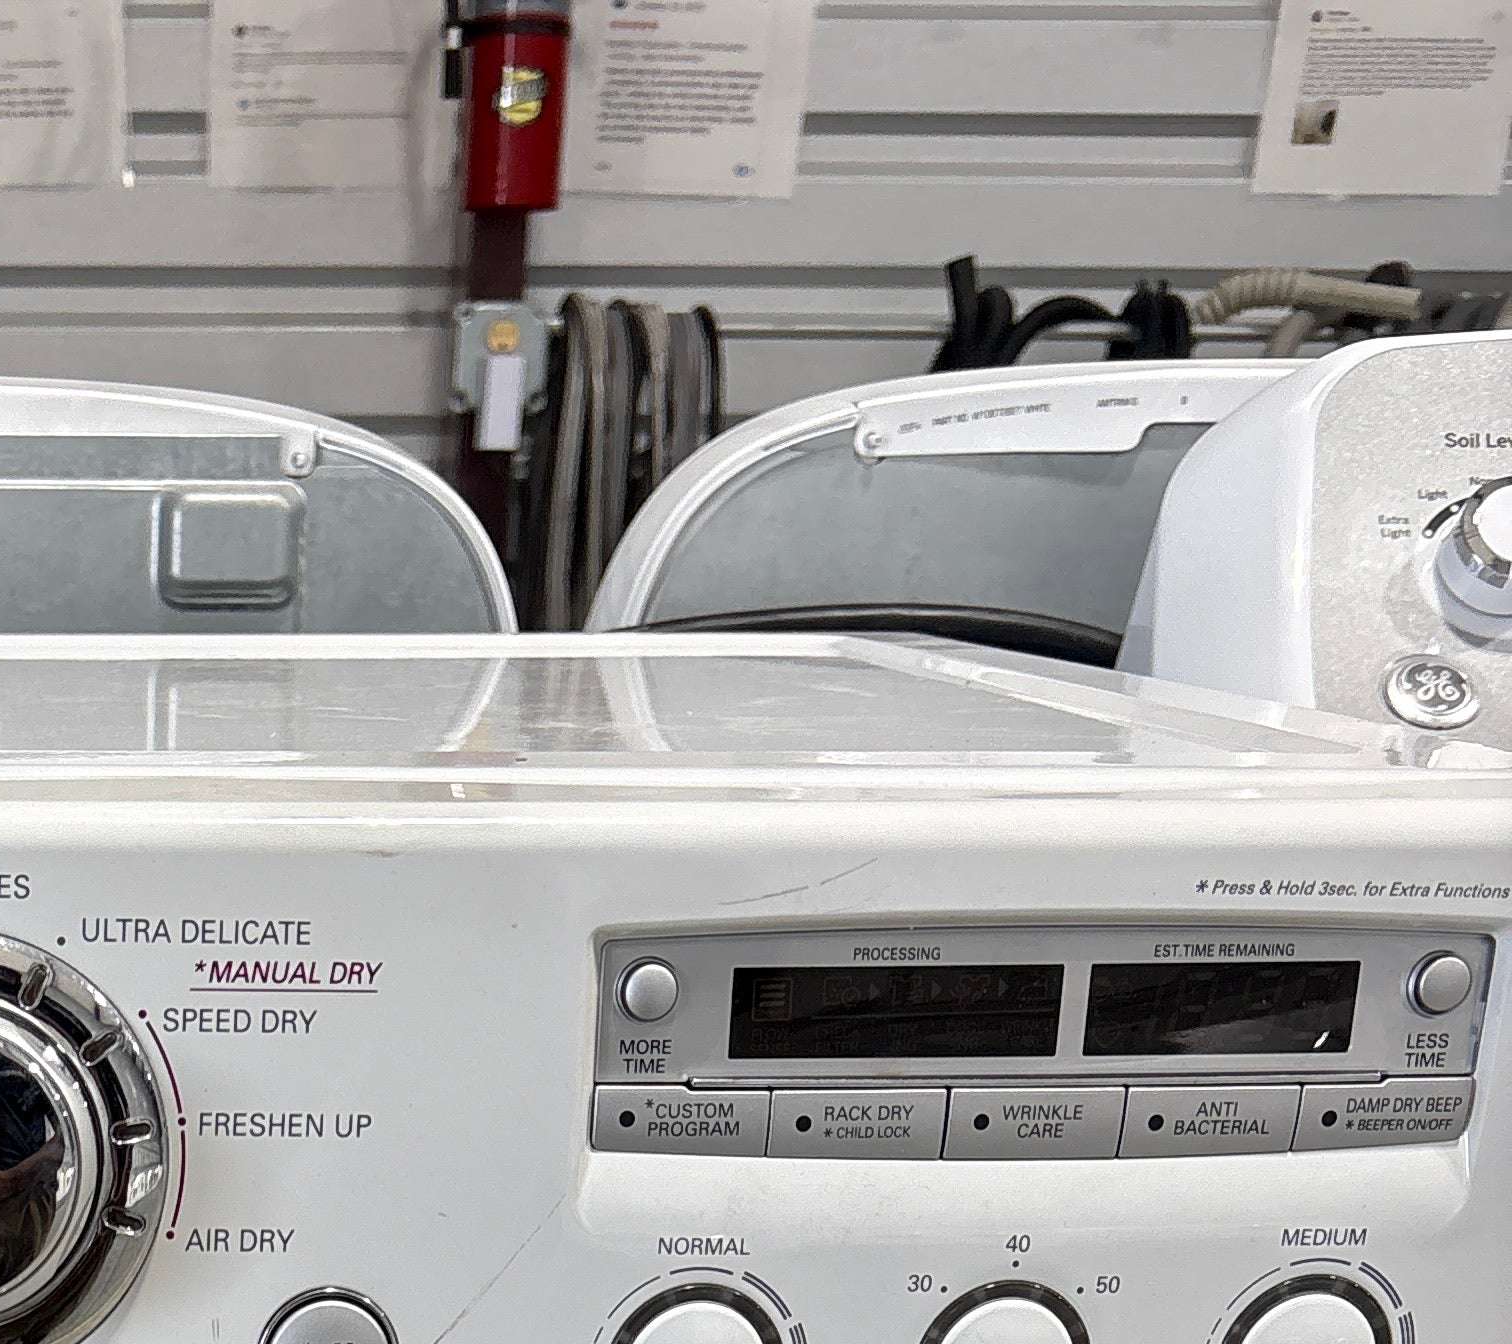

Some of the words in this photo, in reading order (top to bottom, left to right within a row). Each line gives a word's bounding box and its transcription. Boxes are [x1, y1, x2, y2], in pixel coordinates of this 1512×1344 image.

[1444, 433, 1480, 448] Soil
[1212, 880, 1255, 895] Press
[1259, 880, 1272, 895] &
[1277, 880, 1319, 896] Hold
[1318, 881, 1356, 896] 3sec.
[1363, 881, 1387, 896] for
[1390, 882, 1430, 897] Extra
[1434, 882, 1510, 898] Functions
[82, 918, 171, 943] ULTRA
[182, 920, 311, 945] DELICATE
[853, 947, 940, 960] PROCESSING
[1219, 943, 1295, 957] REMAINING
[330, 962, 383, 984] DRY
[163, 1008, 251, 1032] SPEED
[262, 1010, 317, 1034] DRY
[620, 1040, 672, 1054] MORE
[1407, 1033, 1449, 1049] LESS
[623, 1058, 665, 1073] TIME
[1405, 1052, 1446, 1067] TIME
[824, 1106, 872, 1121] RACK
[878, 1105, 914, 1120] DRY
[1003, 1105, 1083, 1120] WRINKLE
[1196, 1101, 1239, 1118] ANTI
[1346, 1098, 1390, 1113] DAMP
[1393, 1098, 1424, 1112] DRY
[1422, 1097, 1462, 1112] BEEP
[199, 1112, 323, 1137] FRESHEN
[336, 1114, 371, 1138] UP
[648, 1118, 739, 1137] PROGRAM
[837, 1127, 874, 1139] CHILD
[878, 1126, 910, 1138] LOCK
[1017, 1123, 1064, 1138] CARE
[1174, 1120, 1269, 1135] BACTERIAL
[1357, 1119, 1404, 1131] BEEPER
[1407, 1119, 1453, 1130] ON/OFF
[185, 1228, 229, 1252] AIR
[240, 1229, 294, 1252] DRY
[1006, 1235, 1030, 1252] 40
[1281, 1228, 1367, 1246] MEDIUM
[658, 1238, 750, 1255] NORMAL
[908, 1274, 932, 1292] 30
[1096, 1276, 1120, 1293] 50
